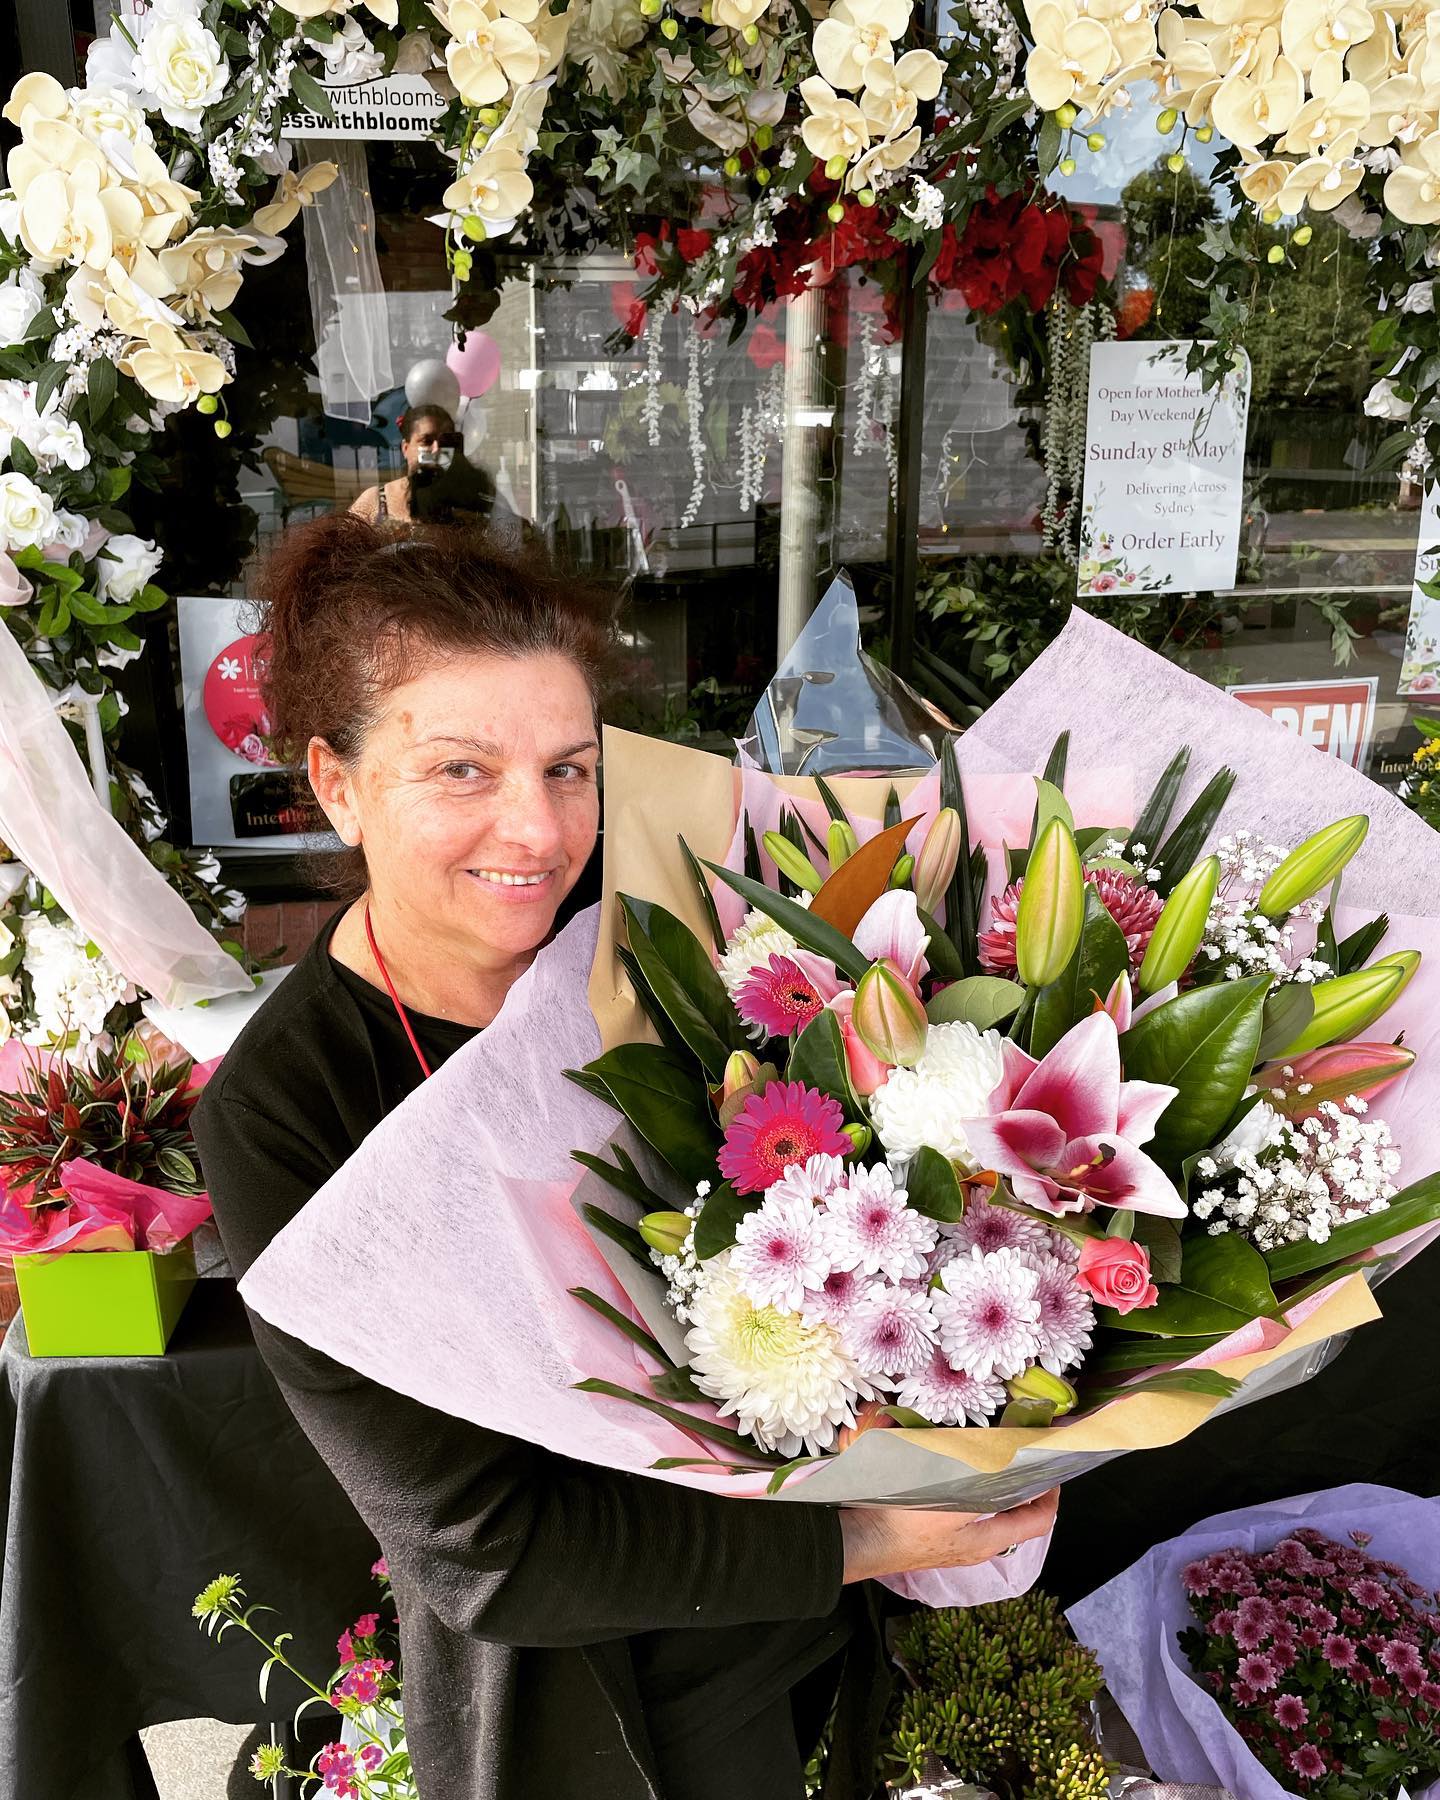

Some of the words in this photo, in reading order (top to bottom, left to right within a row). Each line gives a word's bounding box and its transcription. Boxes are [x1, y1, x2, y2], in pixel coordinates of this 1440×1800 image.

[1098, 387, 1132, 403] Open
[1135, 386, 1153, 399] for
[1111, 409, 1134, 425] Day
[1138, 407, 1195, 421] Weekend
[1089, 441, 1157, 464] Sunday
[1162, 437, 1186, 459] 8th
[1187, 441, 1228, 463] May
[1126, 481, 1186, 496] Delivering
[1189, 480, 1227, 493] Across
[1154, 500, 1196, 517] Sydney
[1122, 531, 1175, 551] Order
[1180, 529, 1226, 552] Early
